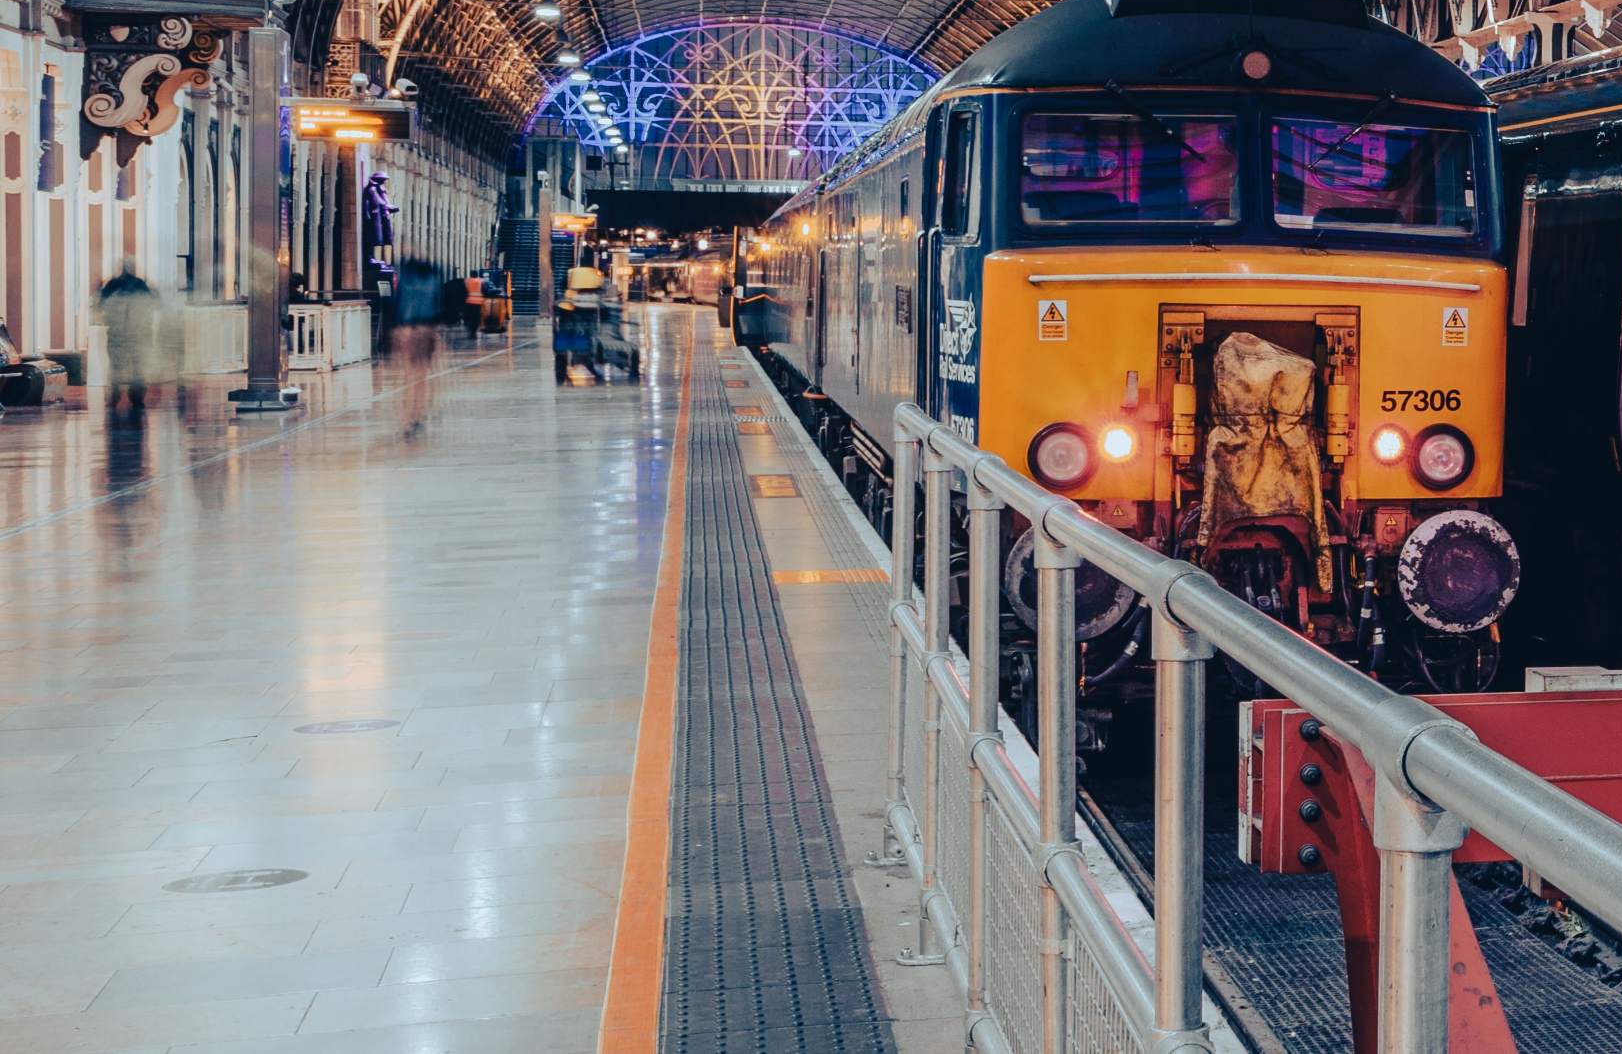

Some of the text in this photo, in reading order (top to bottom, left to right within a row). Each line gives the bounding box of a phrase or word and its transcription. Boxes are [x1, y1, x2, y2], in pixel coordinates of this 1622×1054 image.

[948, 356, 976, 385] Services
[1380, 388, 1462, 413] 57306
[951, 414, 975, 444] 57306
